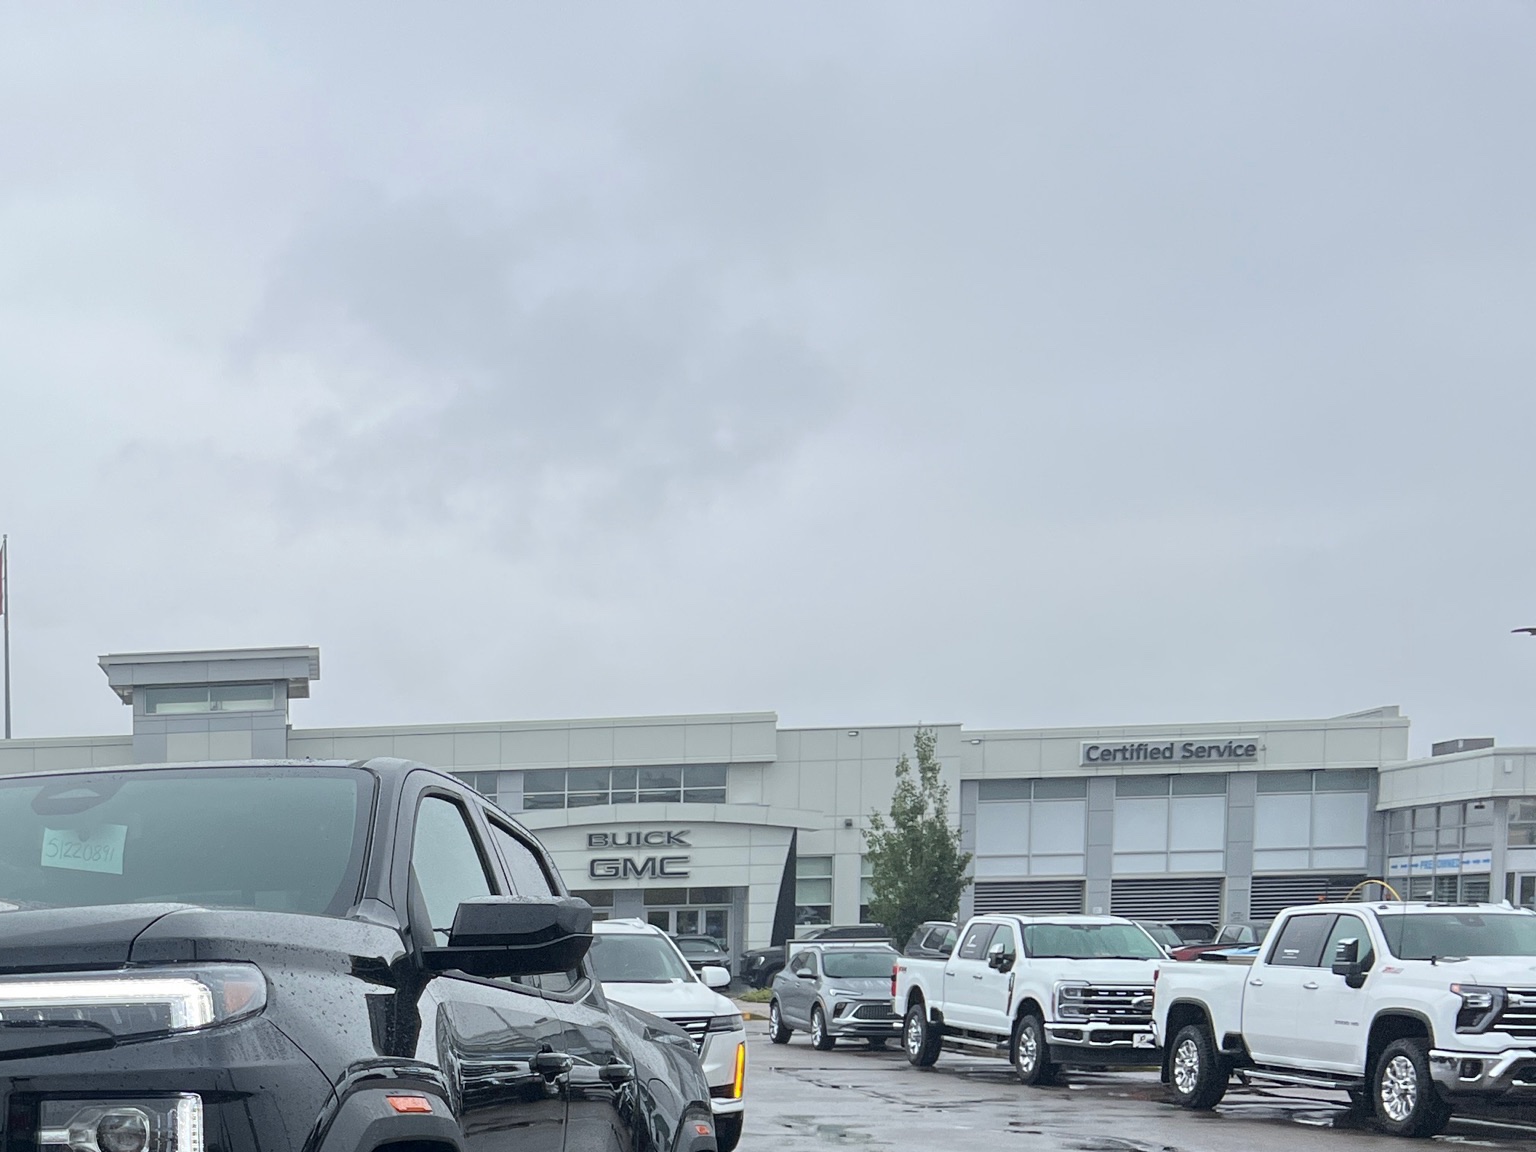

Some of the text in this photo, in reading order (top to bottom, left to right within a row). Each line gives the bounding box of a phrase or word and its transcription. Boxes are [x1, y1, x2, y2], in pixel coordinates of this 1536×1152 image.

[1086, 741, 1256, 762] Certified Service
[587, 830, 692, 849] BUICK
[588, 855, 691, 880] GMC
